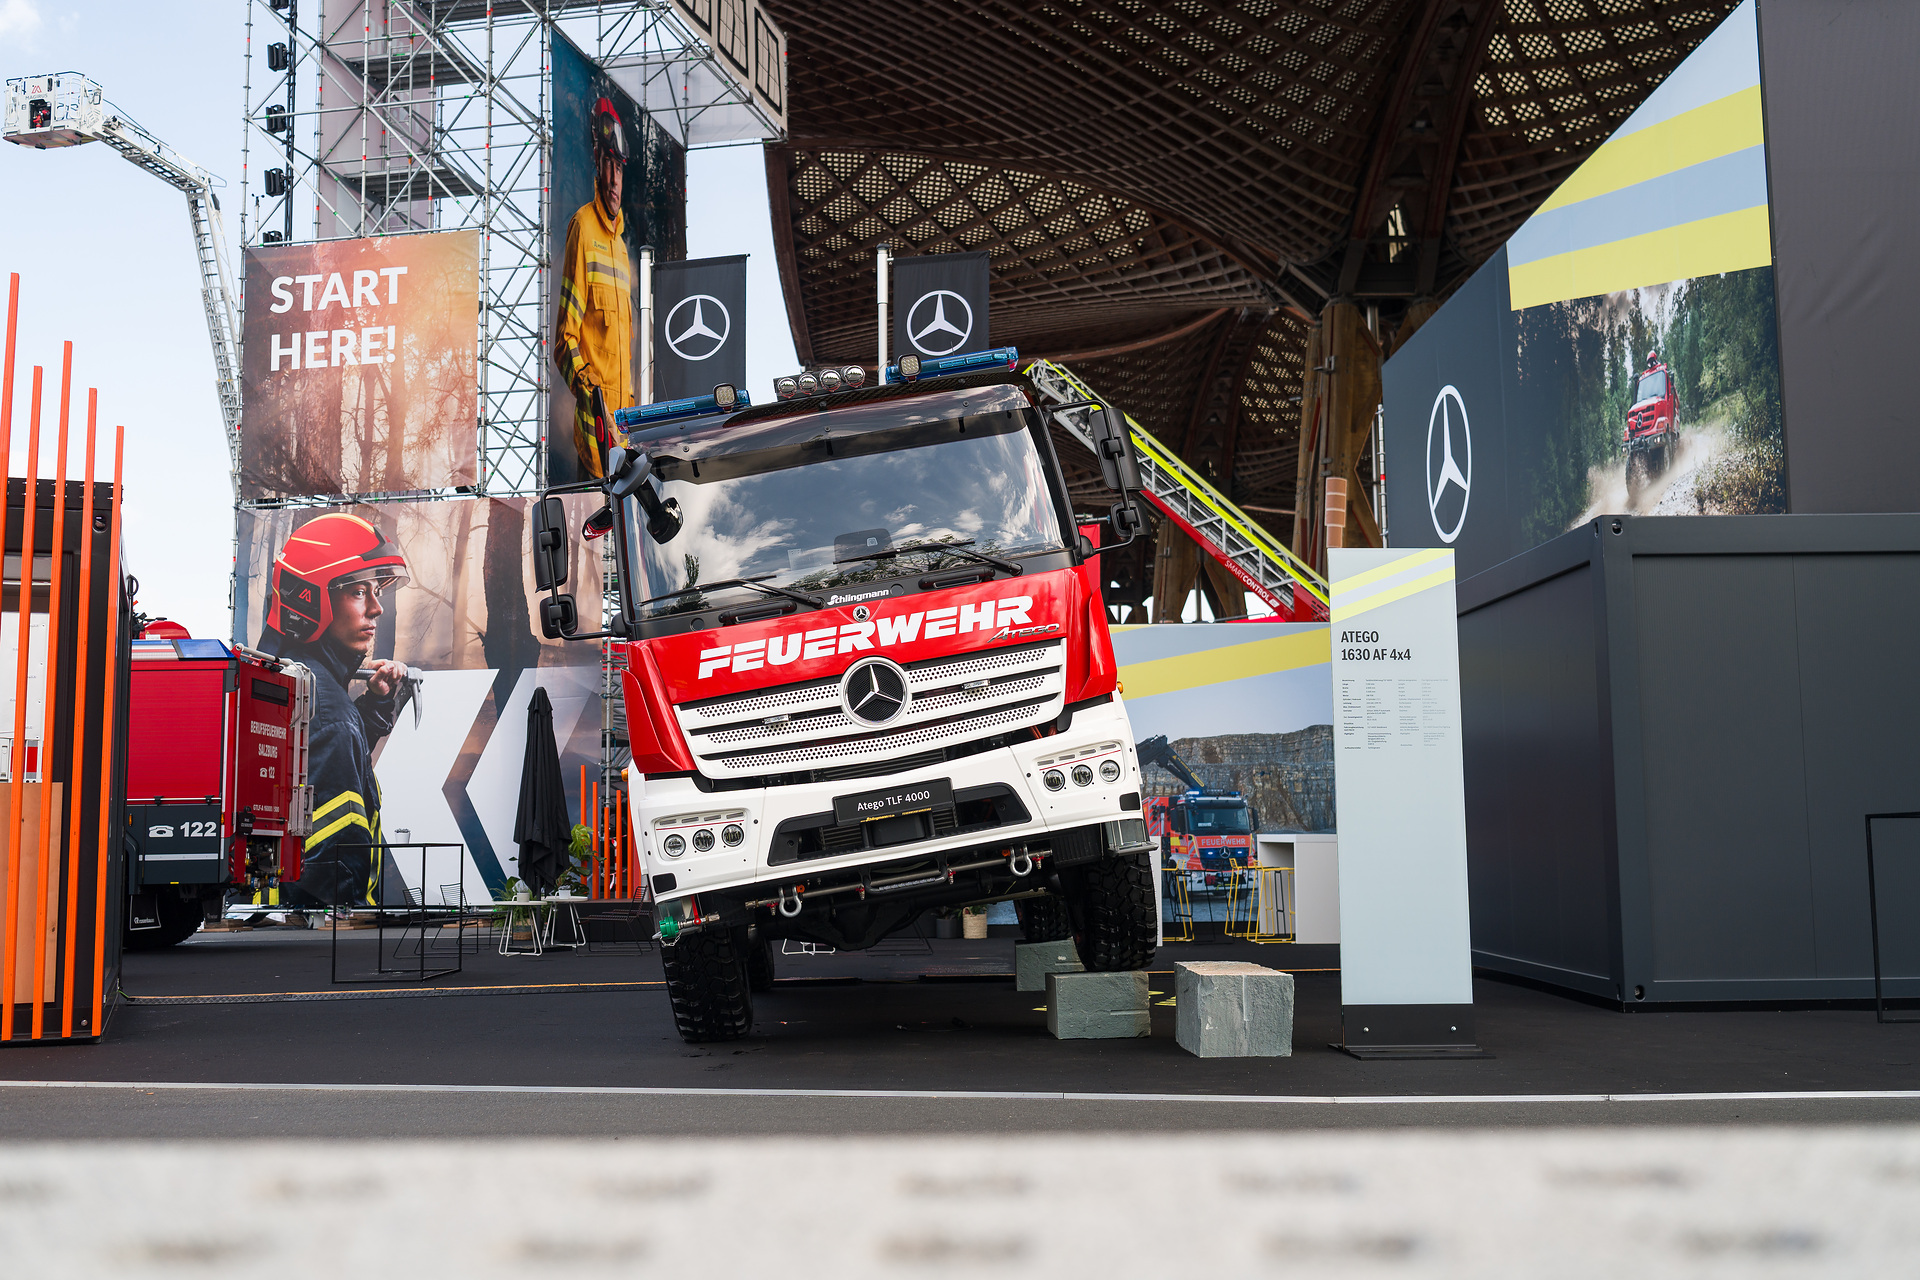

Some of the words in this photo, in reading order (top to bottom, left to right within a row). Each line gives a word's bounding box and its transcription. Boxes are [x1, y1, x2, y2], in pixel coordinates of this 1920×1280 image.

[269, 266, 408, 314] START
[270, 325, 396, 372] HERE!
[1224, 560, 1270, 602] SMARTCONTROL
[827, 589, 889, 606] Schlingmann
[698, 596, 1034, 680] FEUERWEHR
[1340, 630, 1380, 643] ATEGO
[1341, 648, 1371, 661] 1630
[1372, 648, 1388, 661] AF
[1389, 648, 1412, 661] 4x4
[250, 720, 287, 740] BERUFSFEUERWEHR
[258, 743, 278, 759] SALZBURG
[268, 766, 276, 779] 122
[857, 799, 885, 812] Atego
[885, 794, 903, 806] TLF
[904, 790, 931, 803] 4000
[180, 821, 217, 838] 122
[1201, 837, 1246, 846] FEUERWEHR
